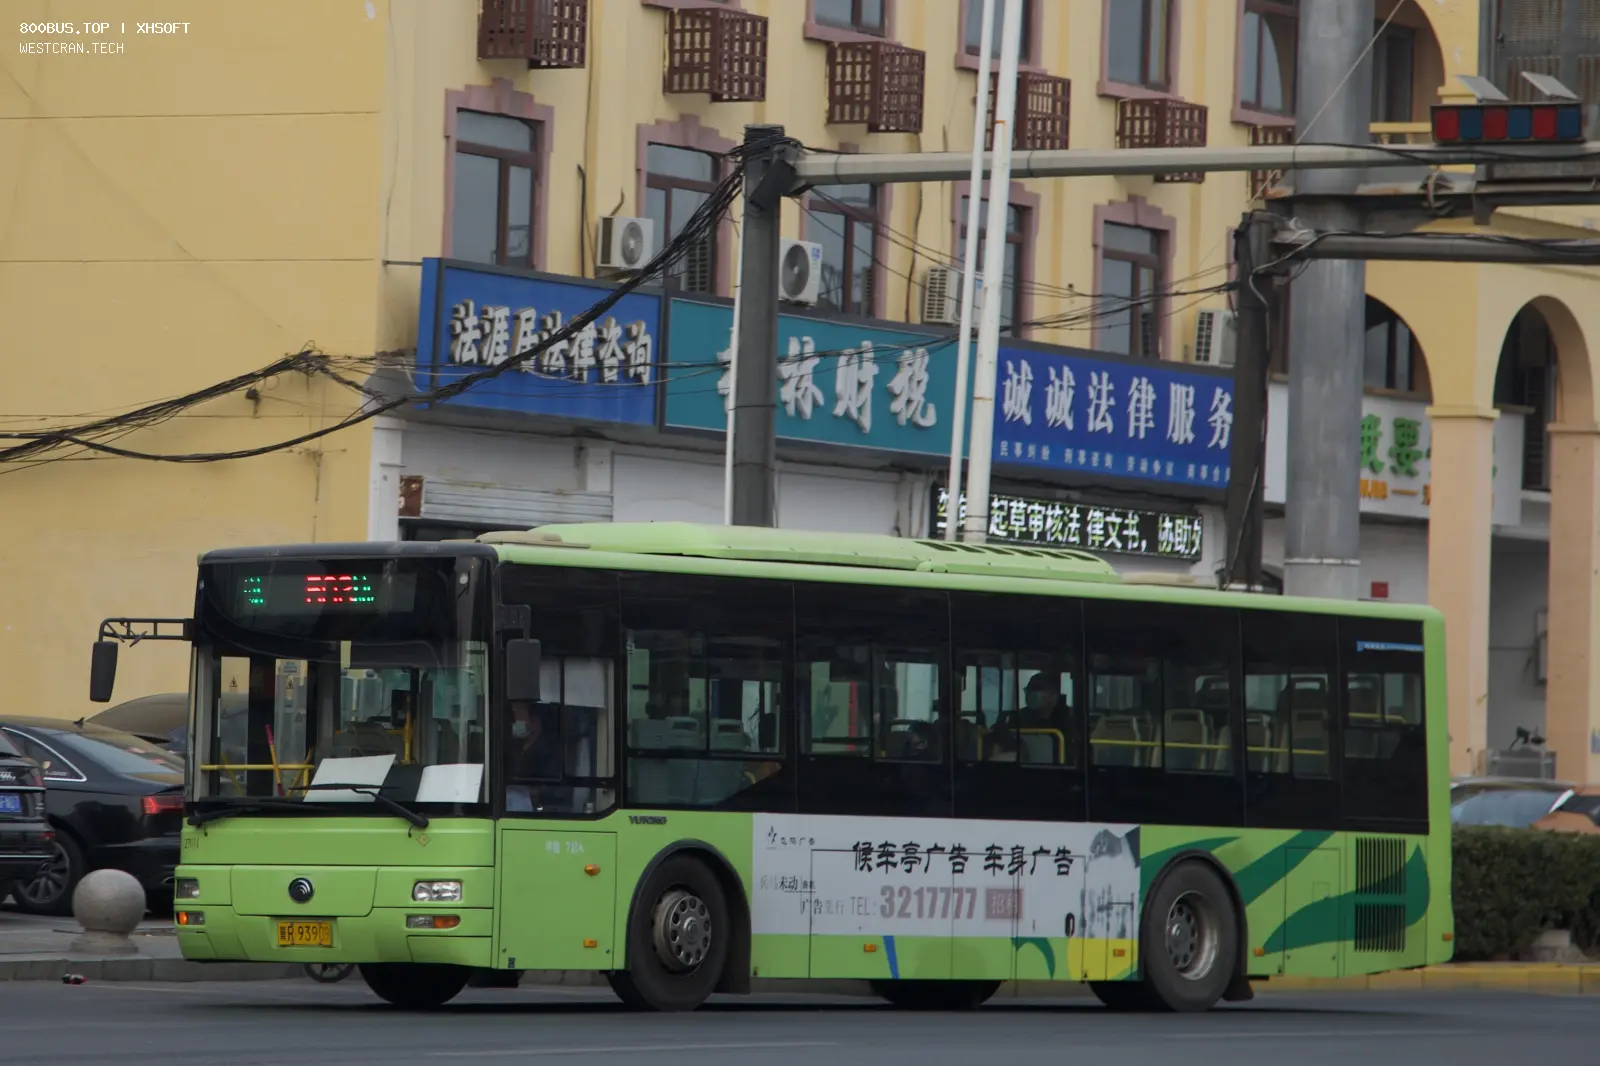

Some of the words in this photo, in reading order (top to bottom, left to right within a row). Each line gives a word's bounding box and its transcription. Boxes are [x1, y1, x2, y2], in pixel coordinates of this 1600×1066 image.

[716, 328, 938, 434] 林财税
[1002, 359, 1233, 450] 诚诚法律服务
[852, 841, 969, 875] 候车亭广告
[983, 845, 1074, 877] 车身广告
[880, 886, 978, 919] 3217777
